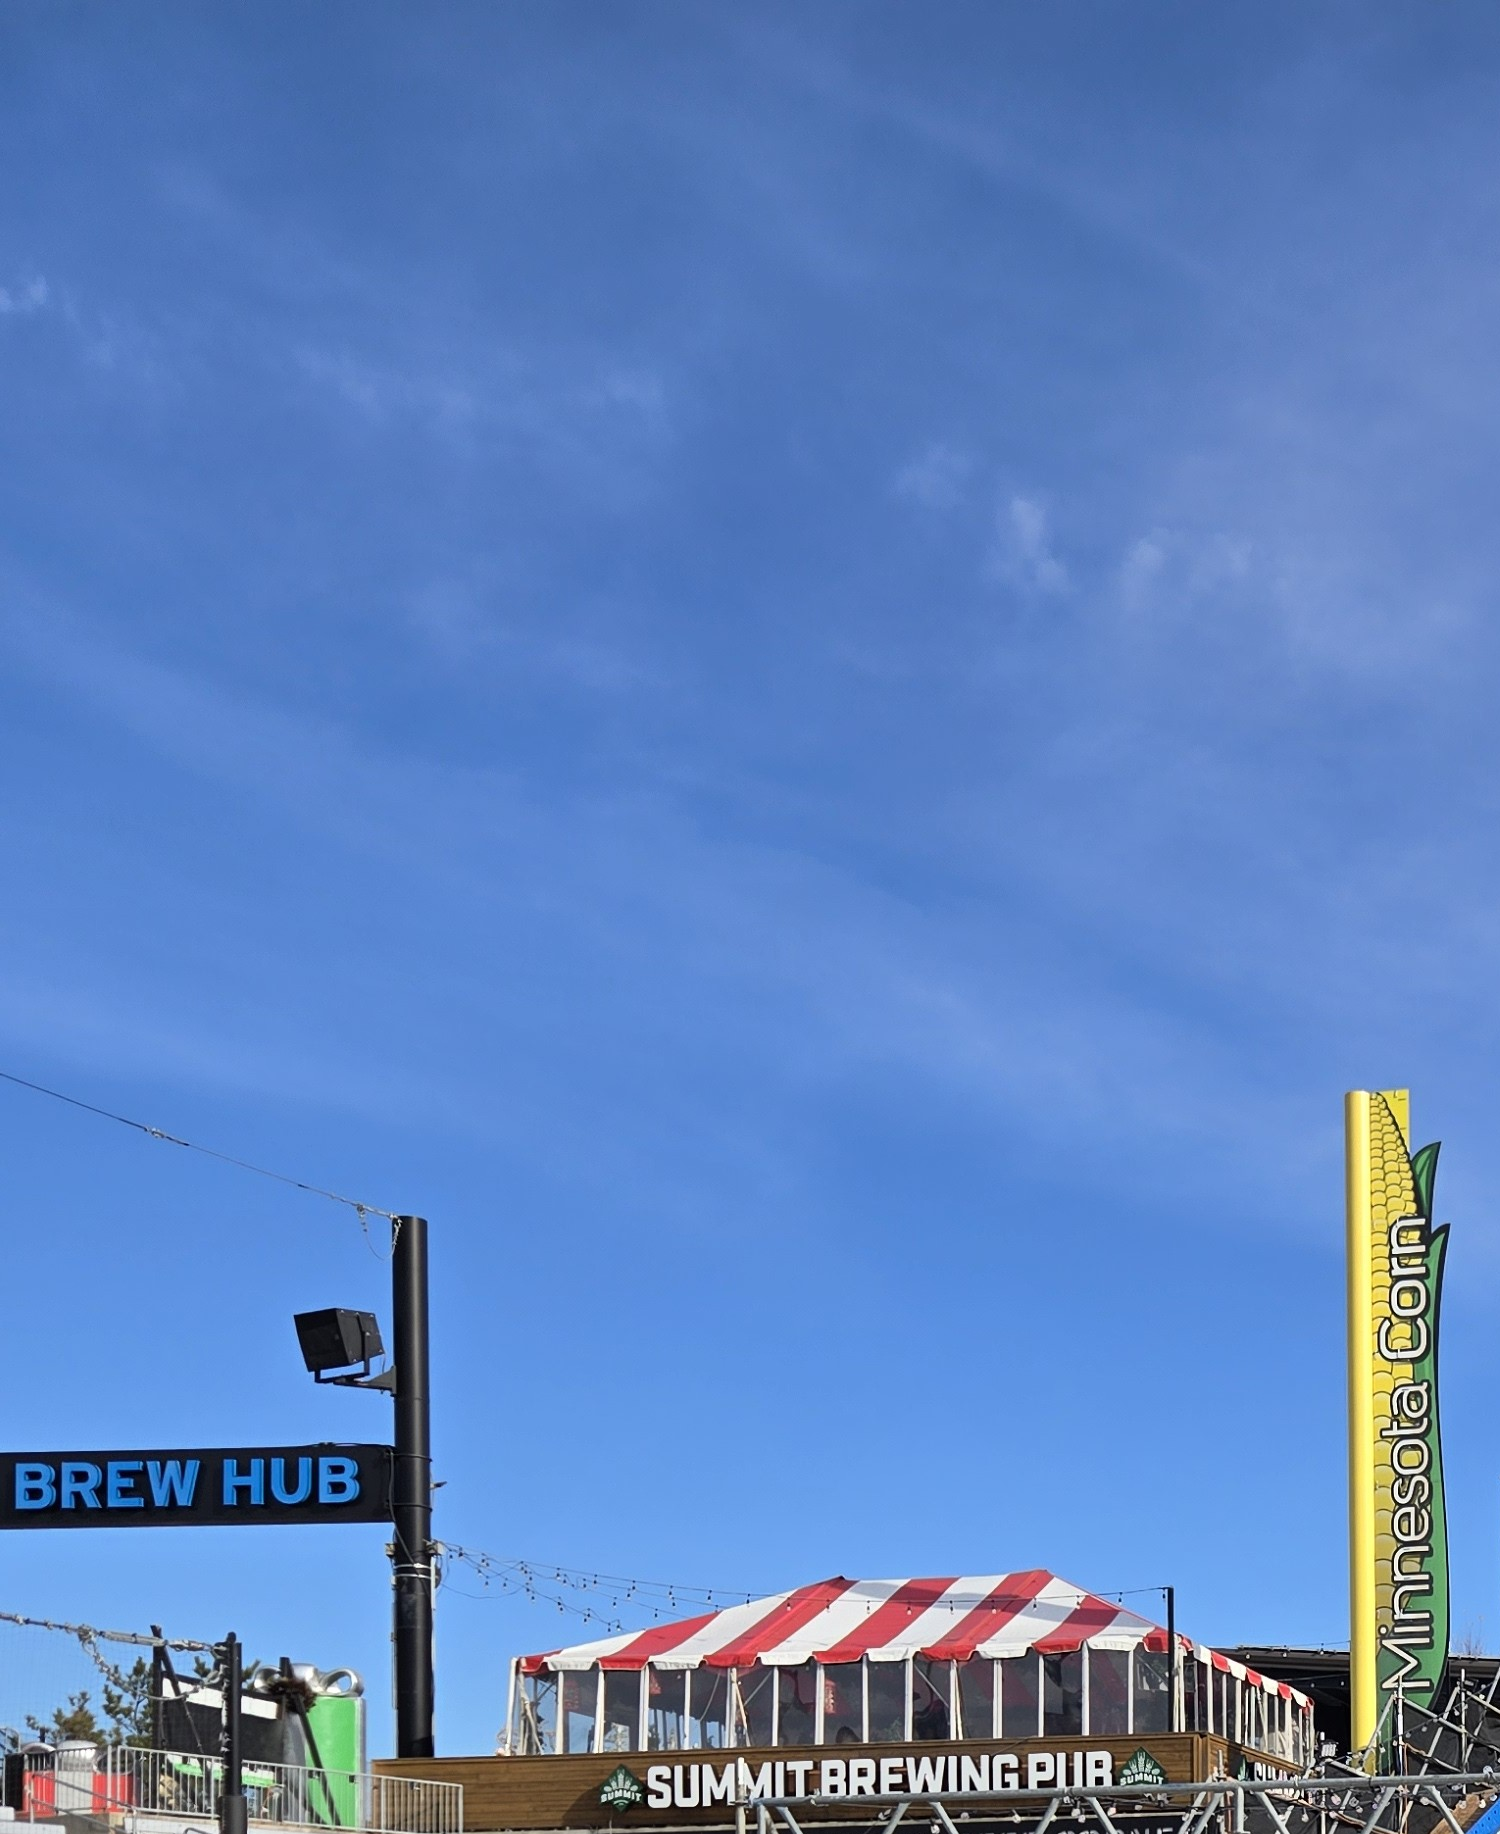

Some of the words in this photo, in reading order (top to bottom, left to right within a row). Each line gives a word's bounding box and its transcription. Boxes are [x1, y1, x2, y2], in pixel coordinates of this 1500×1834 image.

[1378, 1217, 1428, 1361] Corn
[15, 1460, 200, 1510] BREW
[222, 1456, 360, 1506] HUB
[1381, 1381, 1431, 1689] Minnesota
[600, 1789, 643, 1803] SUMMIT
[647, 1761, 814, 1809] SUMMIT
[820, 1754, 1019, 1798] BREWING
[1027, 1750, 1113, 1790] PUB
[1119, 1771, 1165, 1786] SUMMIT
